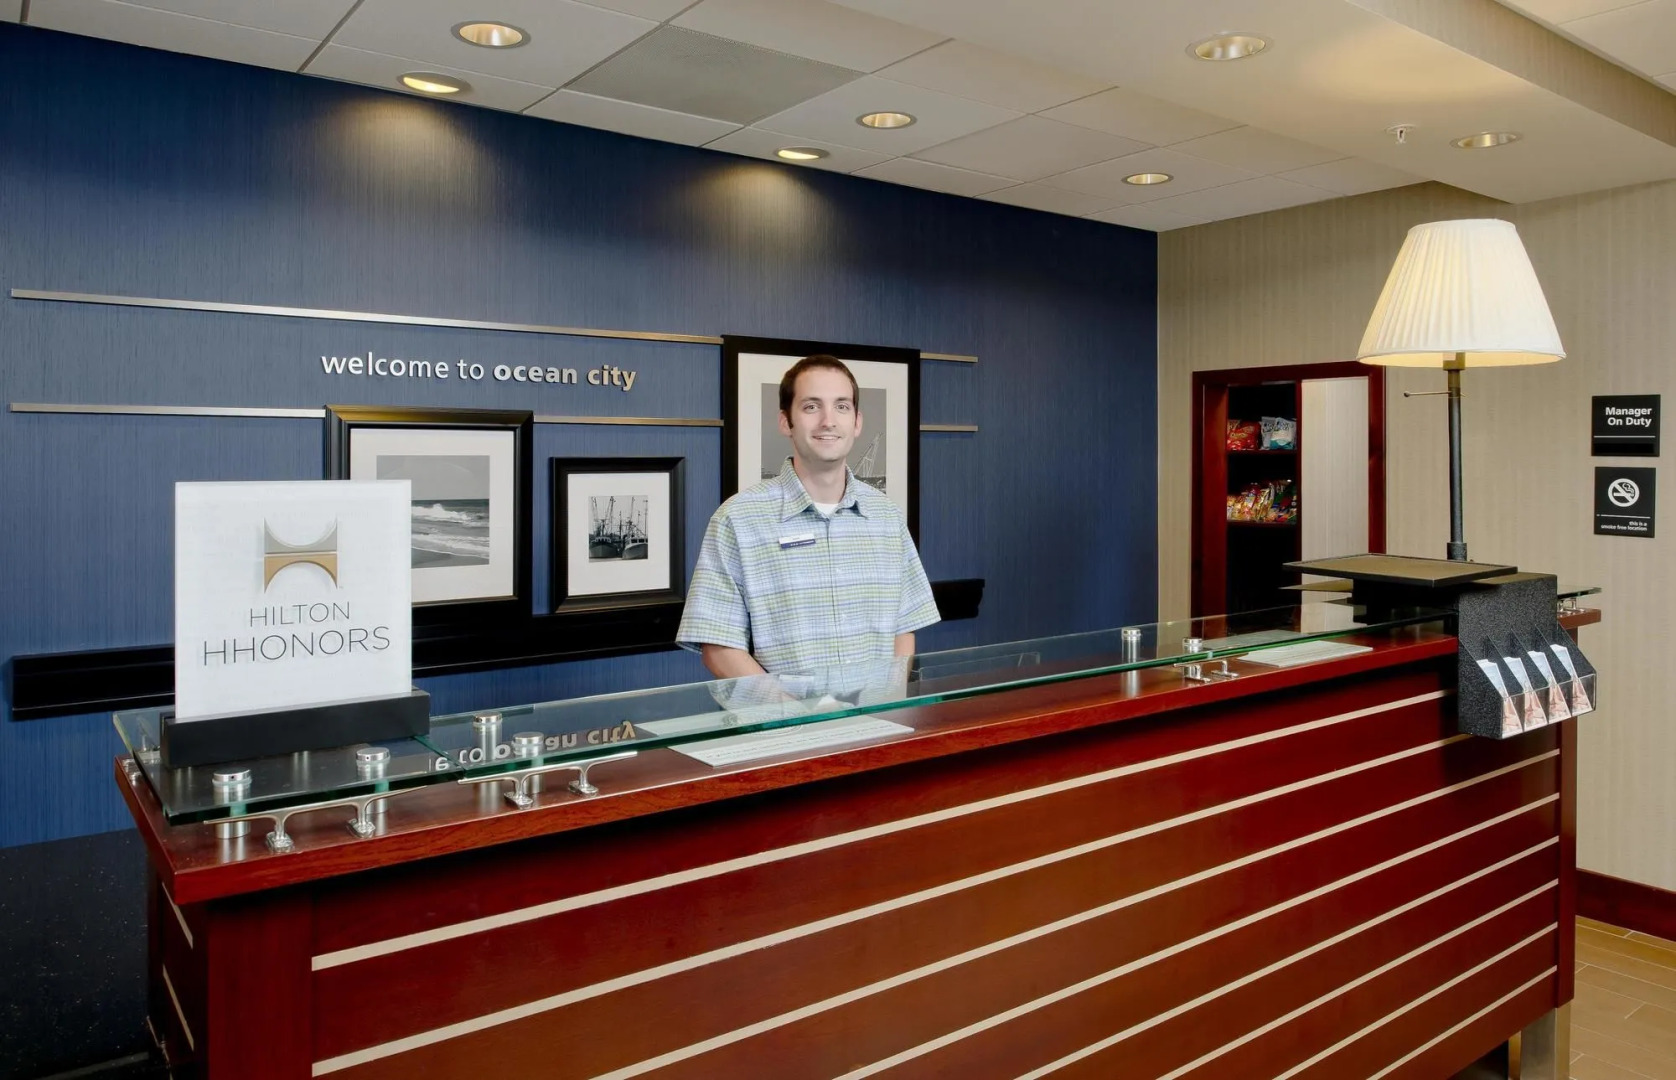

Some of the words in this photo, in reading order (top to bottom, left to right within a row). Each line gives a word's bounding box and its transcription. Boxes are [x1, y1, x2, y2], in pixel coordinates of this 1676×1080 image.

[321, 352, 449, 378] welcome
[457, 359, 485, 380] to
[493, 364, 578, 384] ocean
[587, 365, 636, 391] city
[1605, 407, 1652, 417] Manager
[1608, 417, 1622, 426] On
[1625, 417, 1652, 427] Duty
[250, 601, 350, 627] HILTON
[203, 626, 391, 666] HHONORS
